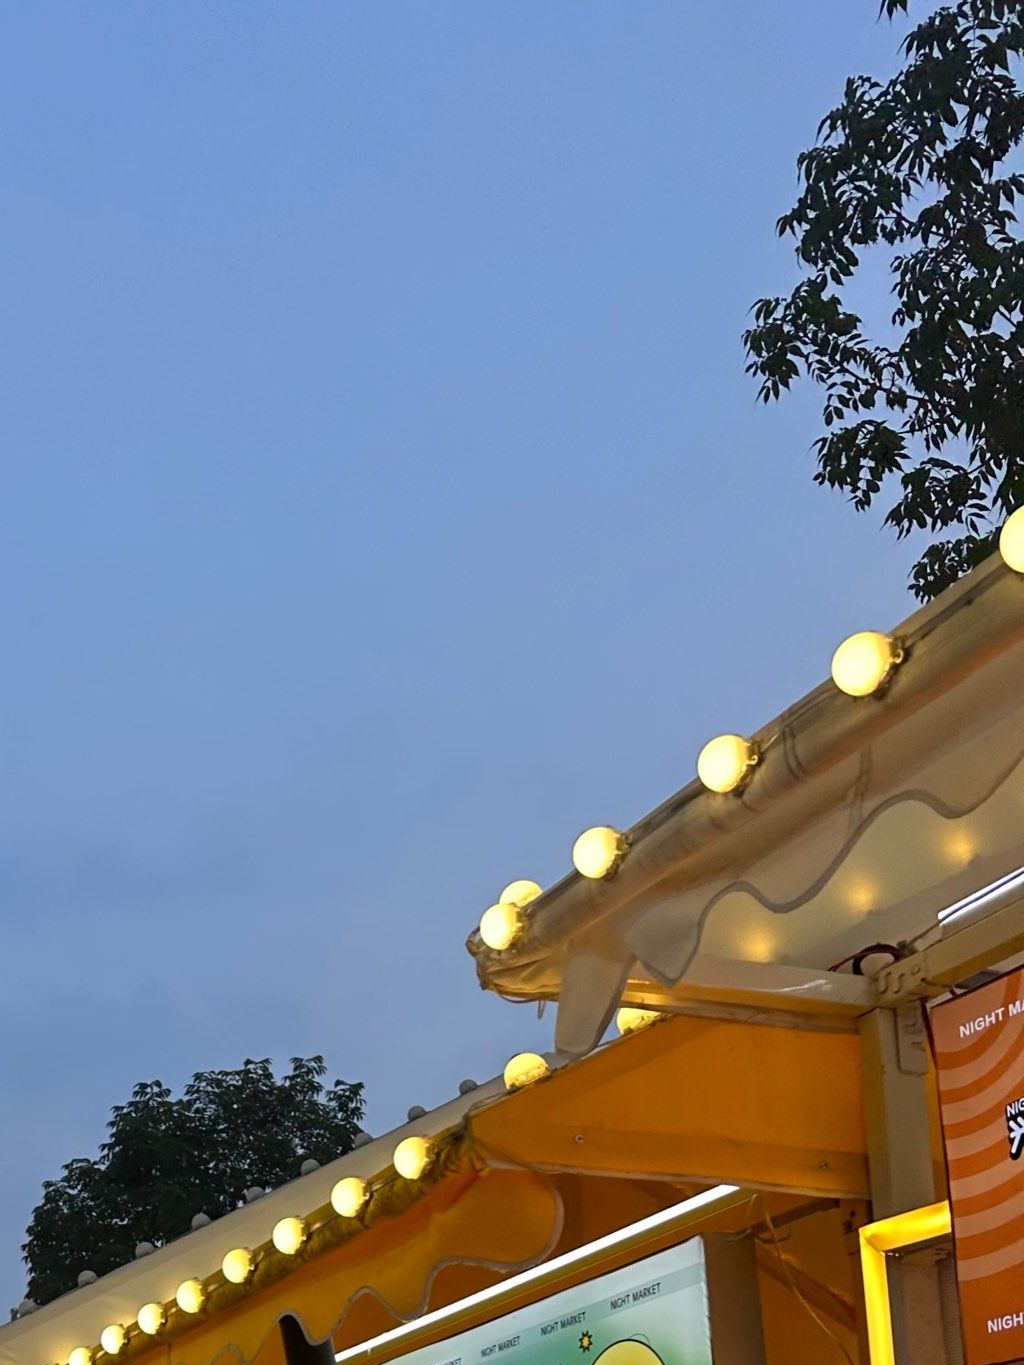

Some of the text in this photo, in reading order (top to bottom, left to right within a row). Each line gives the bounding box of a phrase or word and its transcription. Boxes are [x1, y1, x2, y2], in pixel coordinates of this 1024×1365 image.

[959, 1007, 1004, 1038] NIGHT
[481, 1345, 496, 1357] NIGHT
[498, 1336, 520, 1352] MARKET
[541, 1322, 558, 1336] NIGHT
[561, 1312, 585, 1328] MARKET
[610, 1295, 630, 1310] NIGHT
[632, 1283, 661, 1302] MARKET
[987, 1312, 1024, 1333] NIGH
